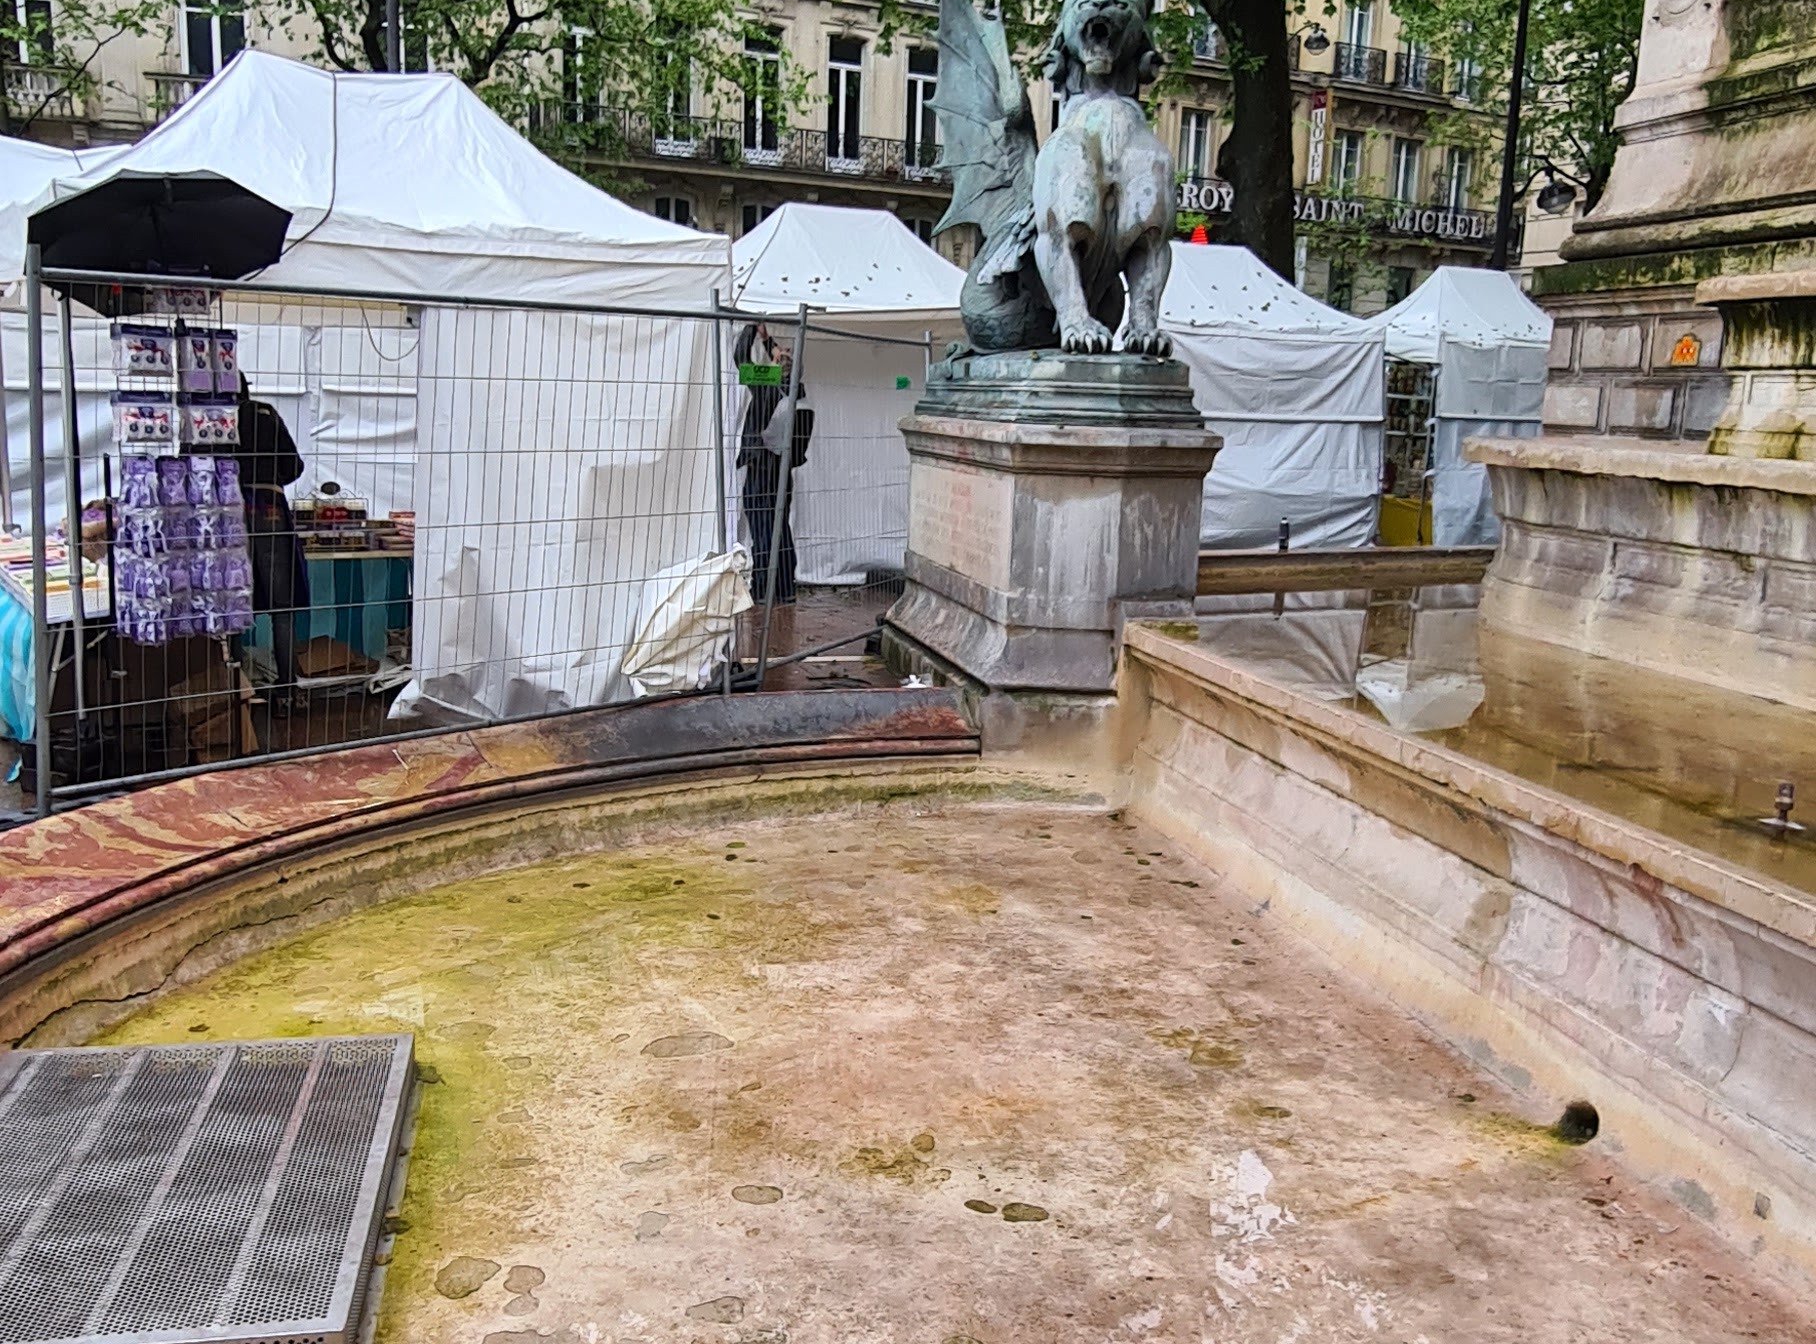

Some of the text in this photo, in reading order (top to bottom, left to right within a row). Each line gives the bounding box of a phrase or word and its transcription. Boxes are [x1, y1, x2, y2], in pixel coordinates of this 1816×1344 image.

[1310, 110, 1325, 183] HOTEL
[1180, 182, 1234, 212] ROY
[1389, 207, 1485, 239] MICHEL
